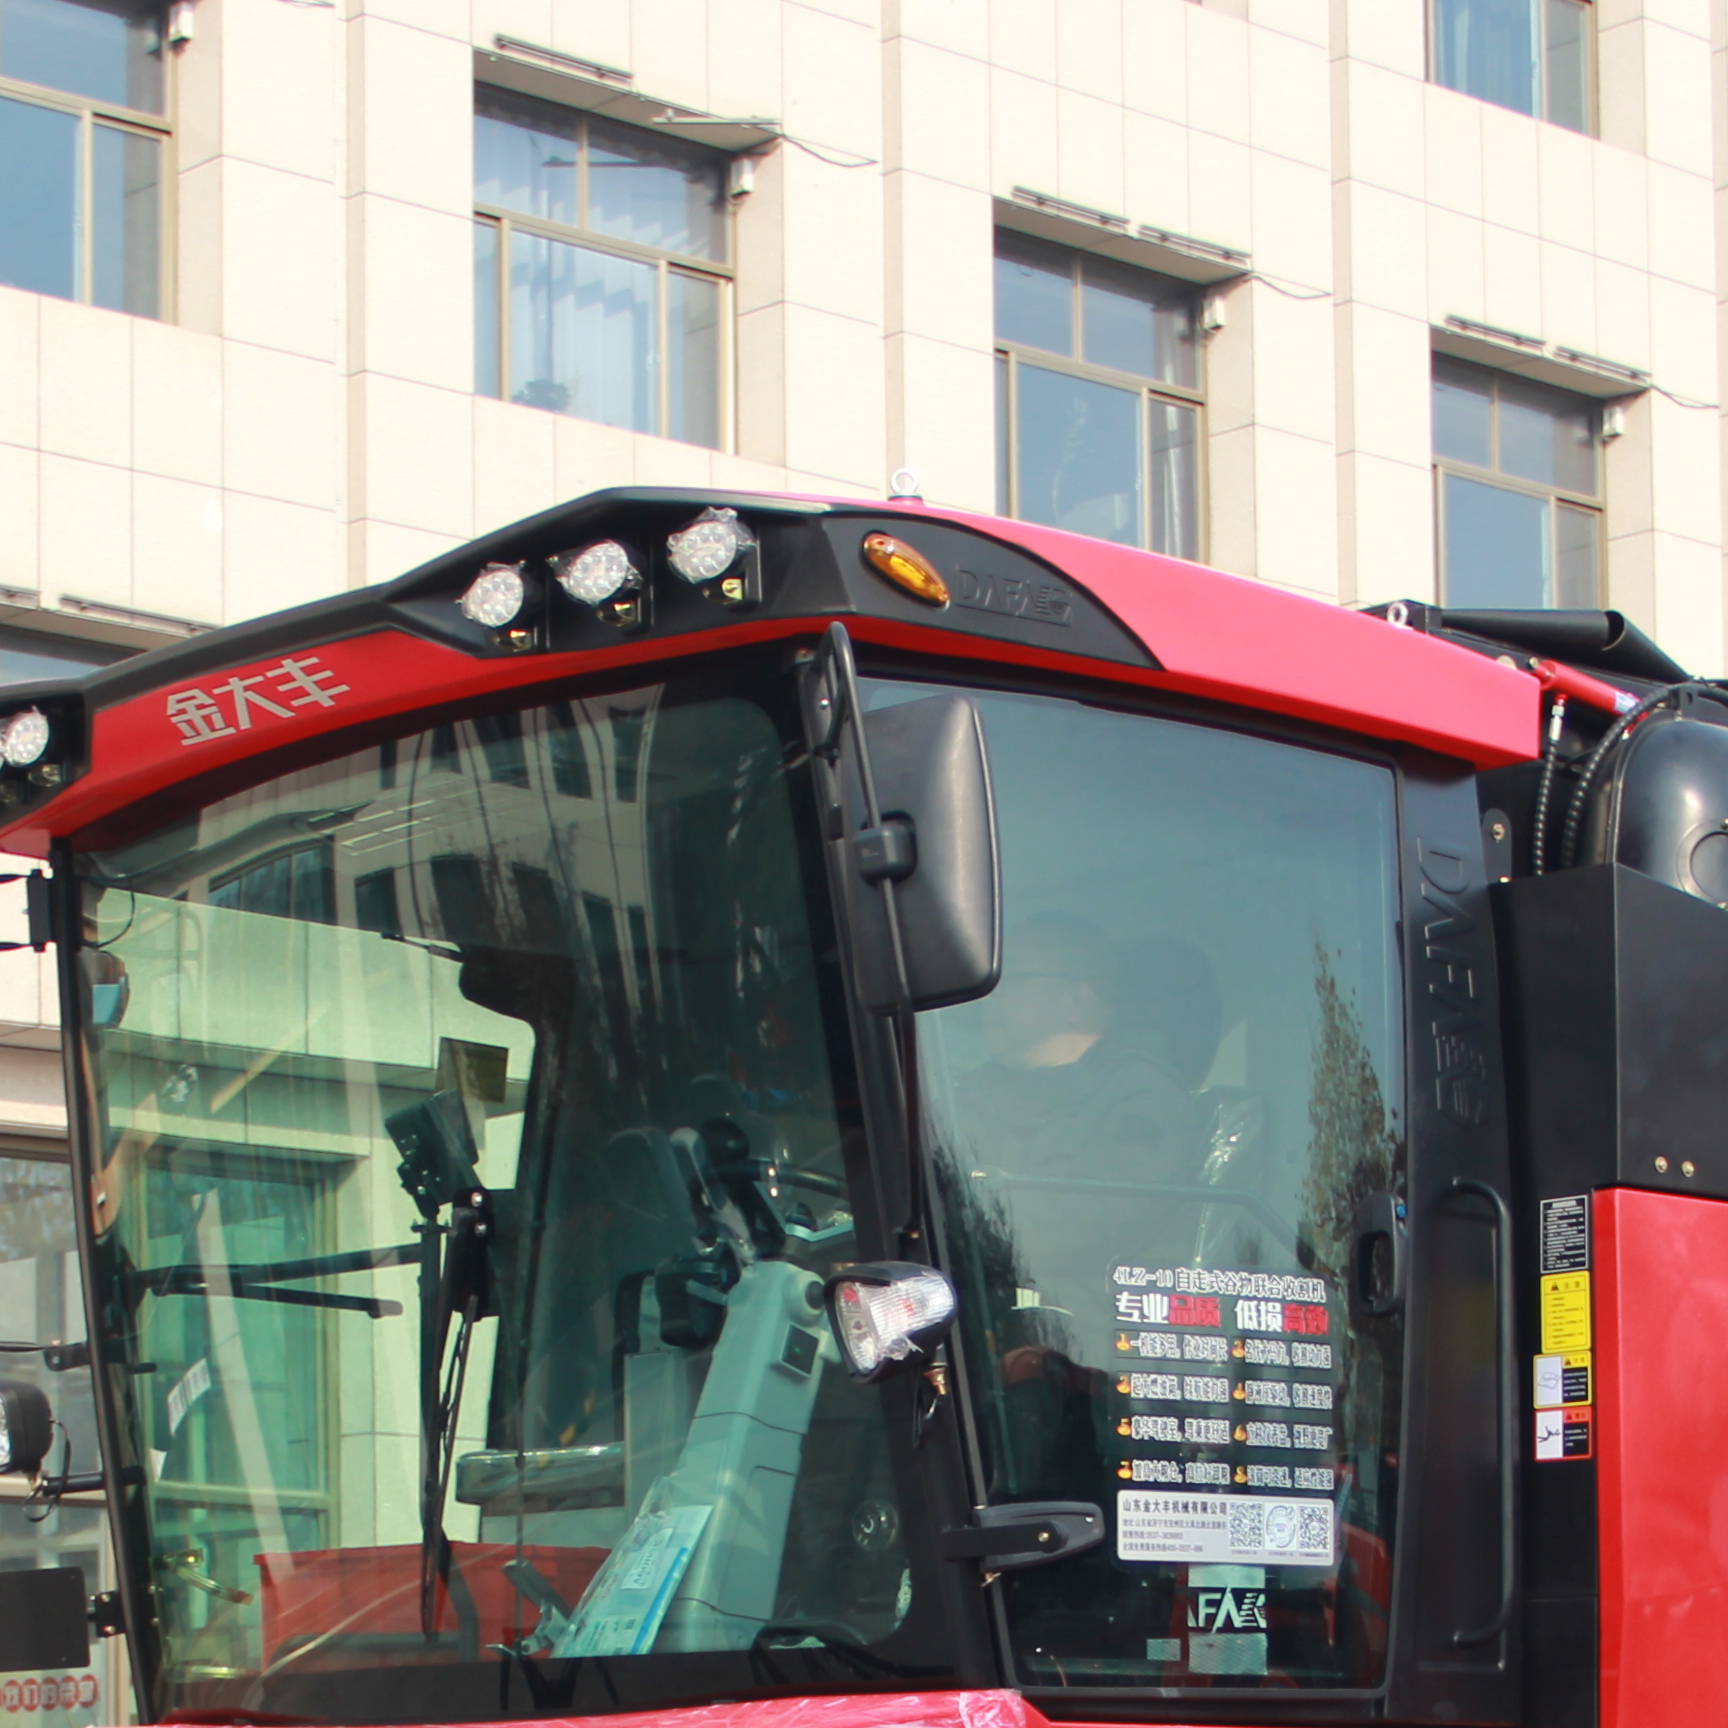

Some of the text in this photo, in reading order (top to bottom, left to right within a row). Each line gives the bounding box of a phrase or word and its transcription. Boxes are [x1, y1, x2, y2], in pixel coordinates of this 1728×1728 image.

[167, 657, 351, 746] 金大丰
[1112, 1266, 1173, 1288] 4LZ-10
[1116, 1291, 1329, 1335] 专业品质 低损高效
[1122, 1499, 1227, 1515] 山东金大丰机械有限公司
